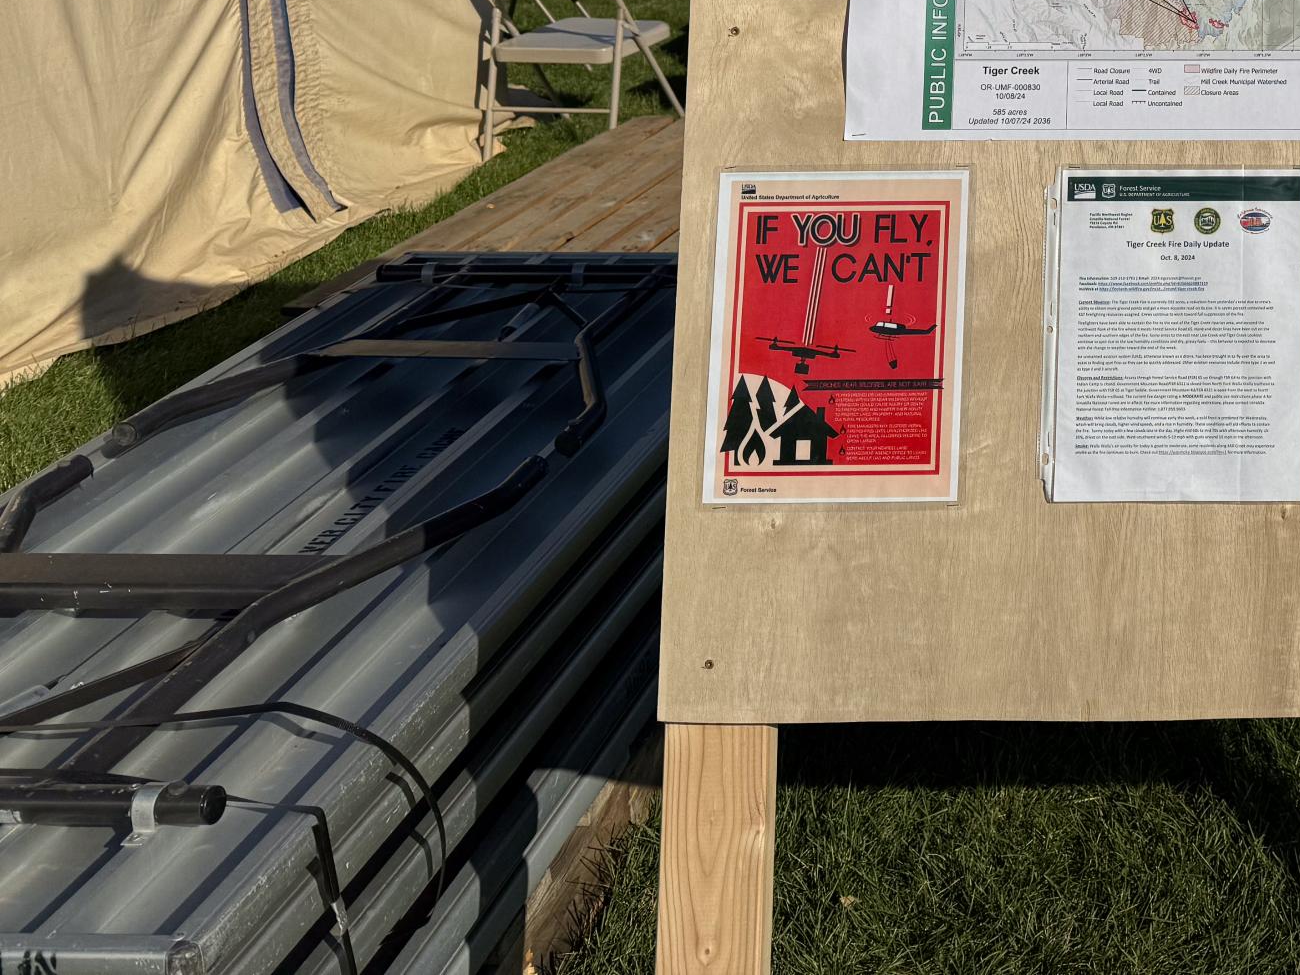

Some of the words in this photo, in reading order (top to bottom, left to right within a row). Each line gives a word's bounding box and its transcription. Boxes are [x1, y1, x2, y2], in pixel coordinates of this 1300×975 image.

[982, 66, 1008, 77] Tiger
[1010, 66, 1040, 76] Creek
[1223, 67, 1239, 75] Daily
[928, 48, 947, 124] PUBLIC
[1228, 78, 1254, 86] Municipal
[995, 92, 1026, 101] 10/08/24
[992, 108, 1006, 116] 585
[968, 117, 1000, 125] Updated
[1001, 117, 1031, 125] 10/07/24
[1032, 117, 1051, 125] 2036
[1074, 183, 1096, 191] USDA
[756, 215, 779, 245] IF
[792, 212, 861, 247] YOU
[874, 213, 933, 247] FLY,
[1126, 240, 1145, 249] Tiger
[1146, 240, 1167, 248] Creek
[1168, 240, 1182, 248] Fire
[1183, 240, 1202, 250] Daily
[1203, 240, 1230, 249] Update
[1173, 254, 1180, 262] 8,
[756, 254, 800, 284] WE
[831, 252, 932, 284] CAN'T
[333, 495, 385, 528] CITY
